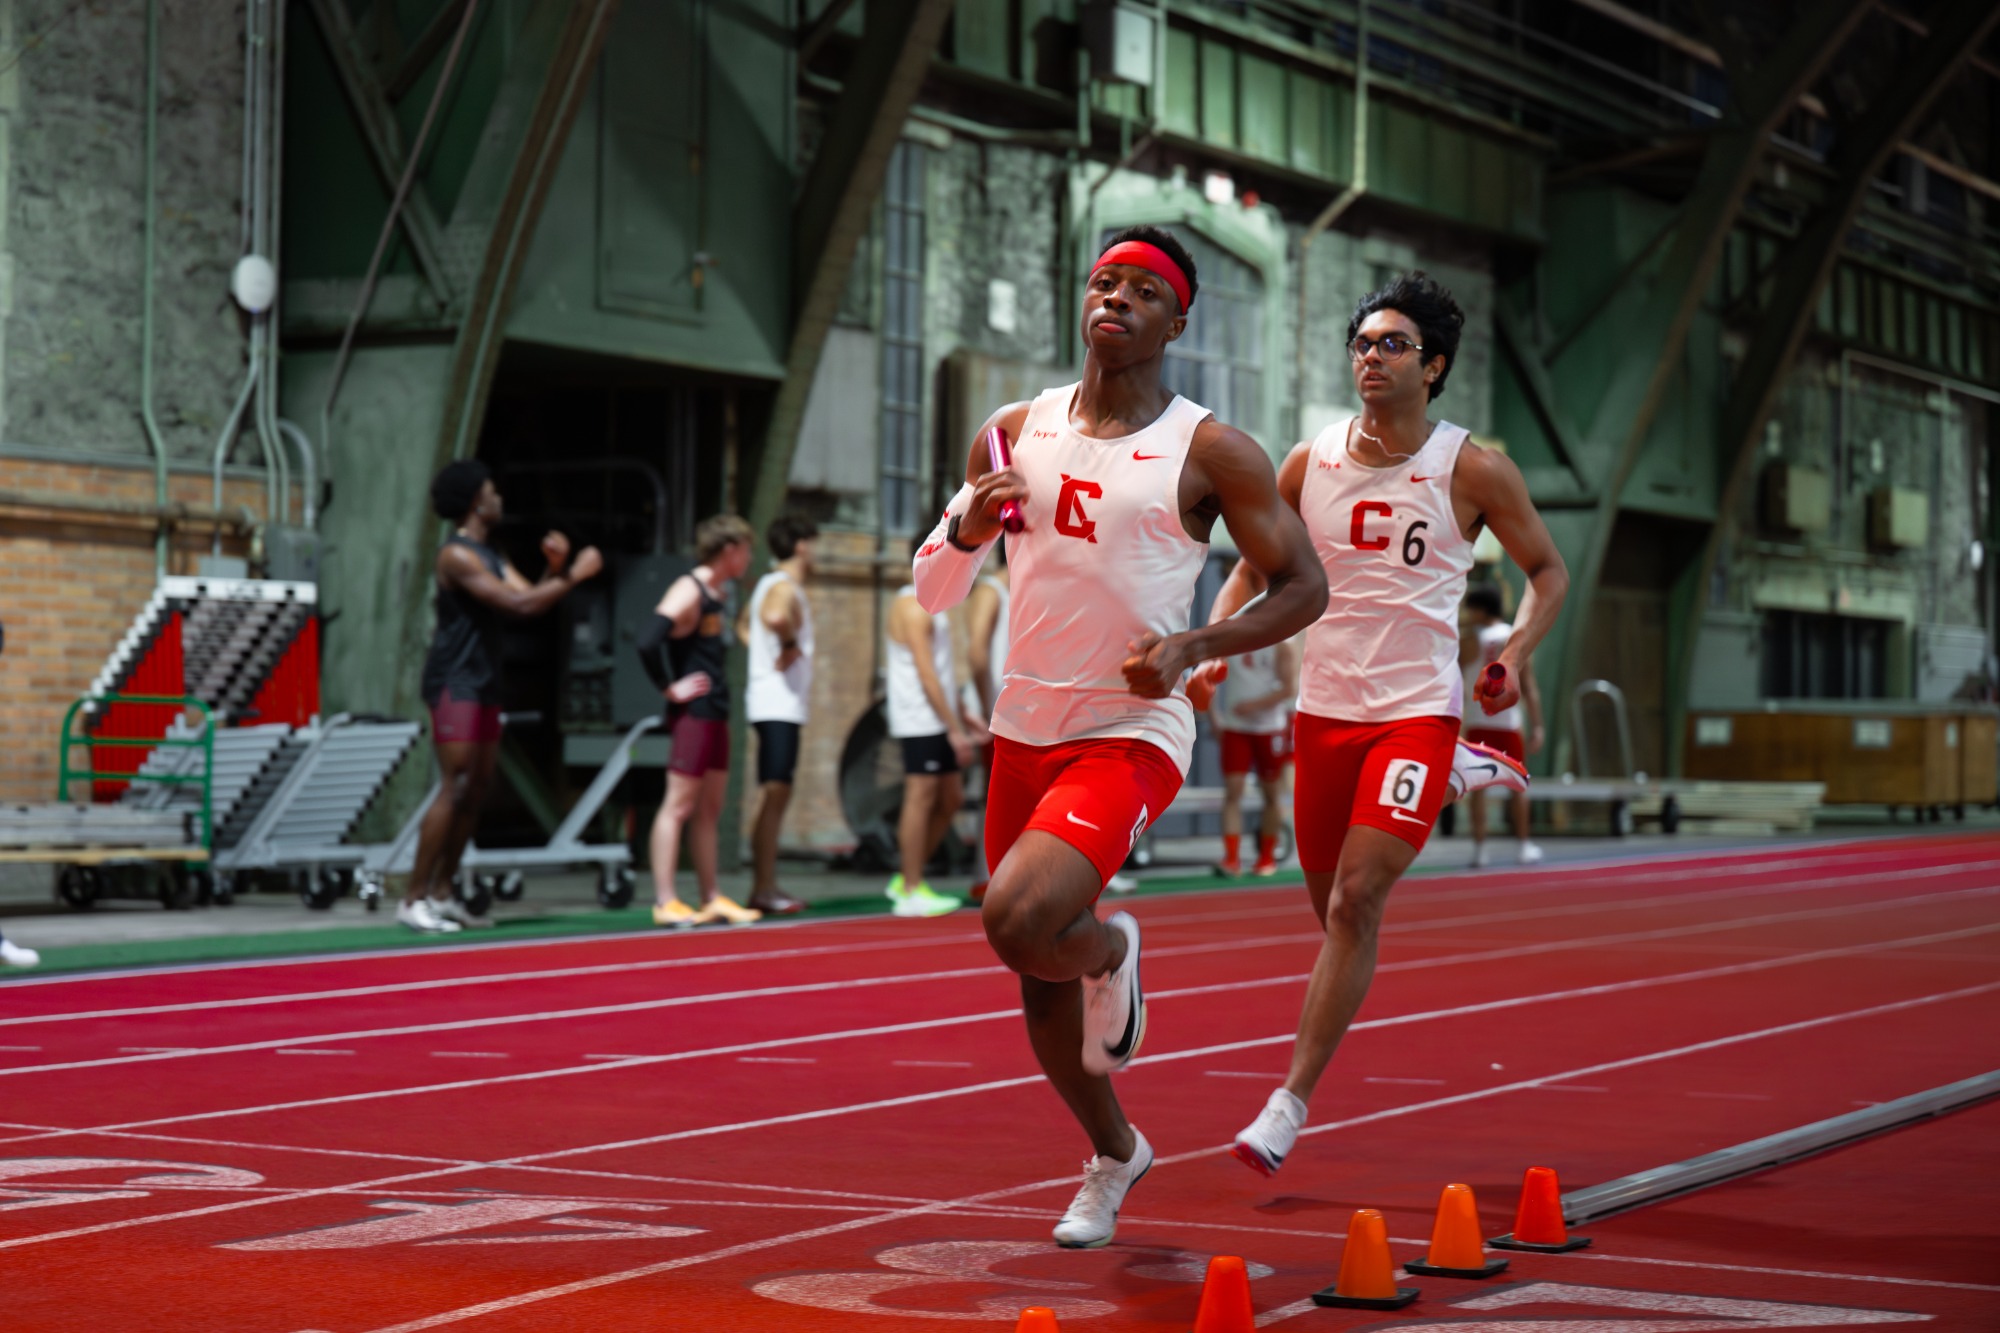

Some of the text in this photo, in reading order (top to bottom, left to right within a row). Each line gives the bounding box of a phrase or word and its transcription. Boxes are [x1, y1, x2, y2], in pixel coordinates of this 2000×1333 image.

[1033, 430, 1050, 440] Ivy
[1350, 500, 1392, 550] C
[1402, 520, 1428, 566] 6
[1392, 763, 1419, 804] 6
[751, 1240, 1276, 1321] 3
